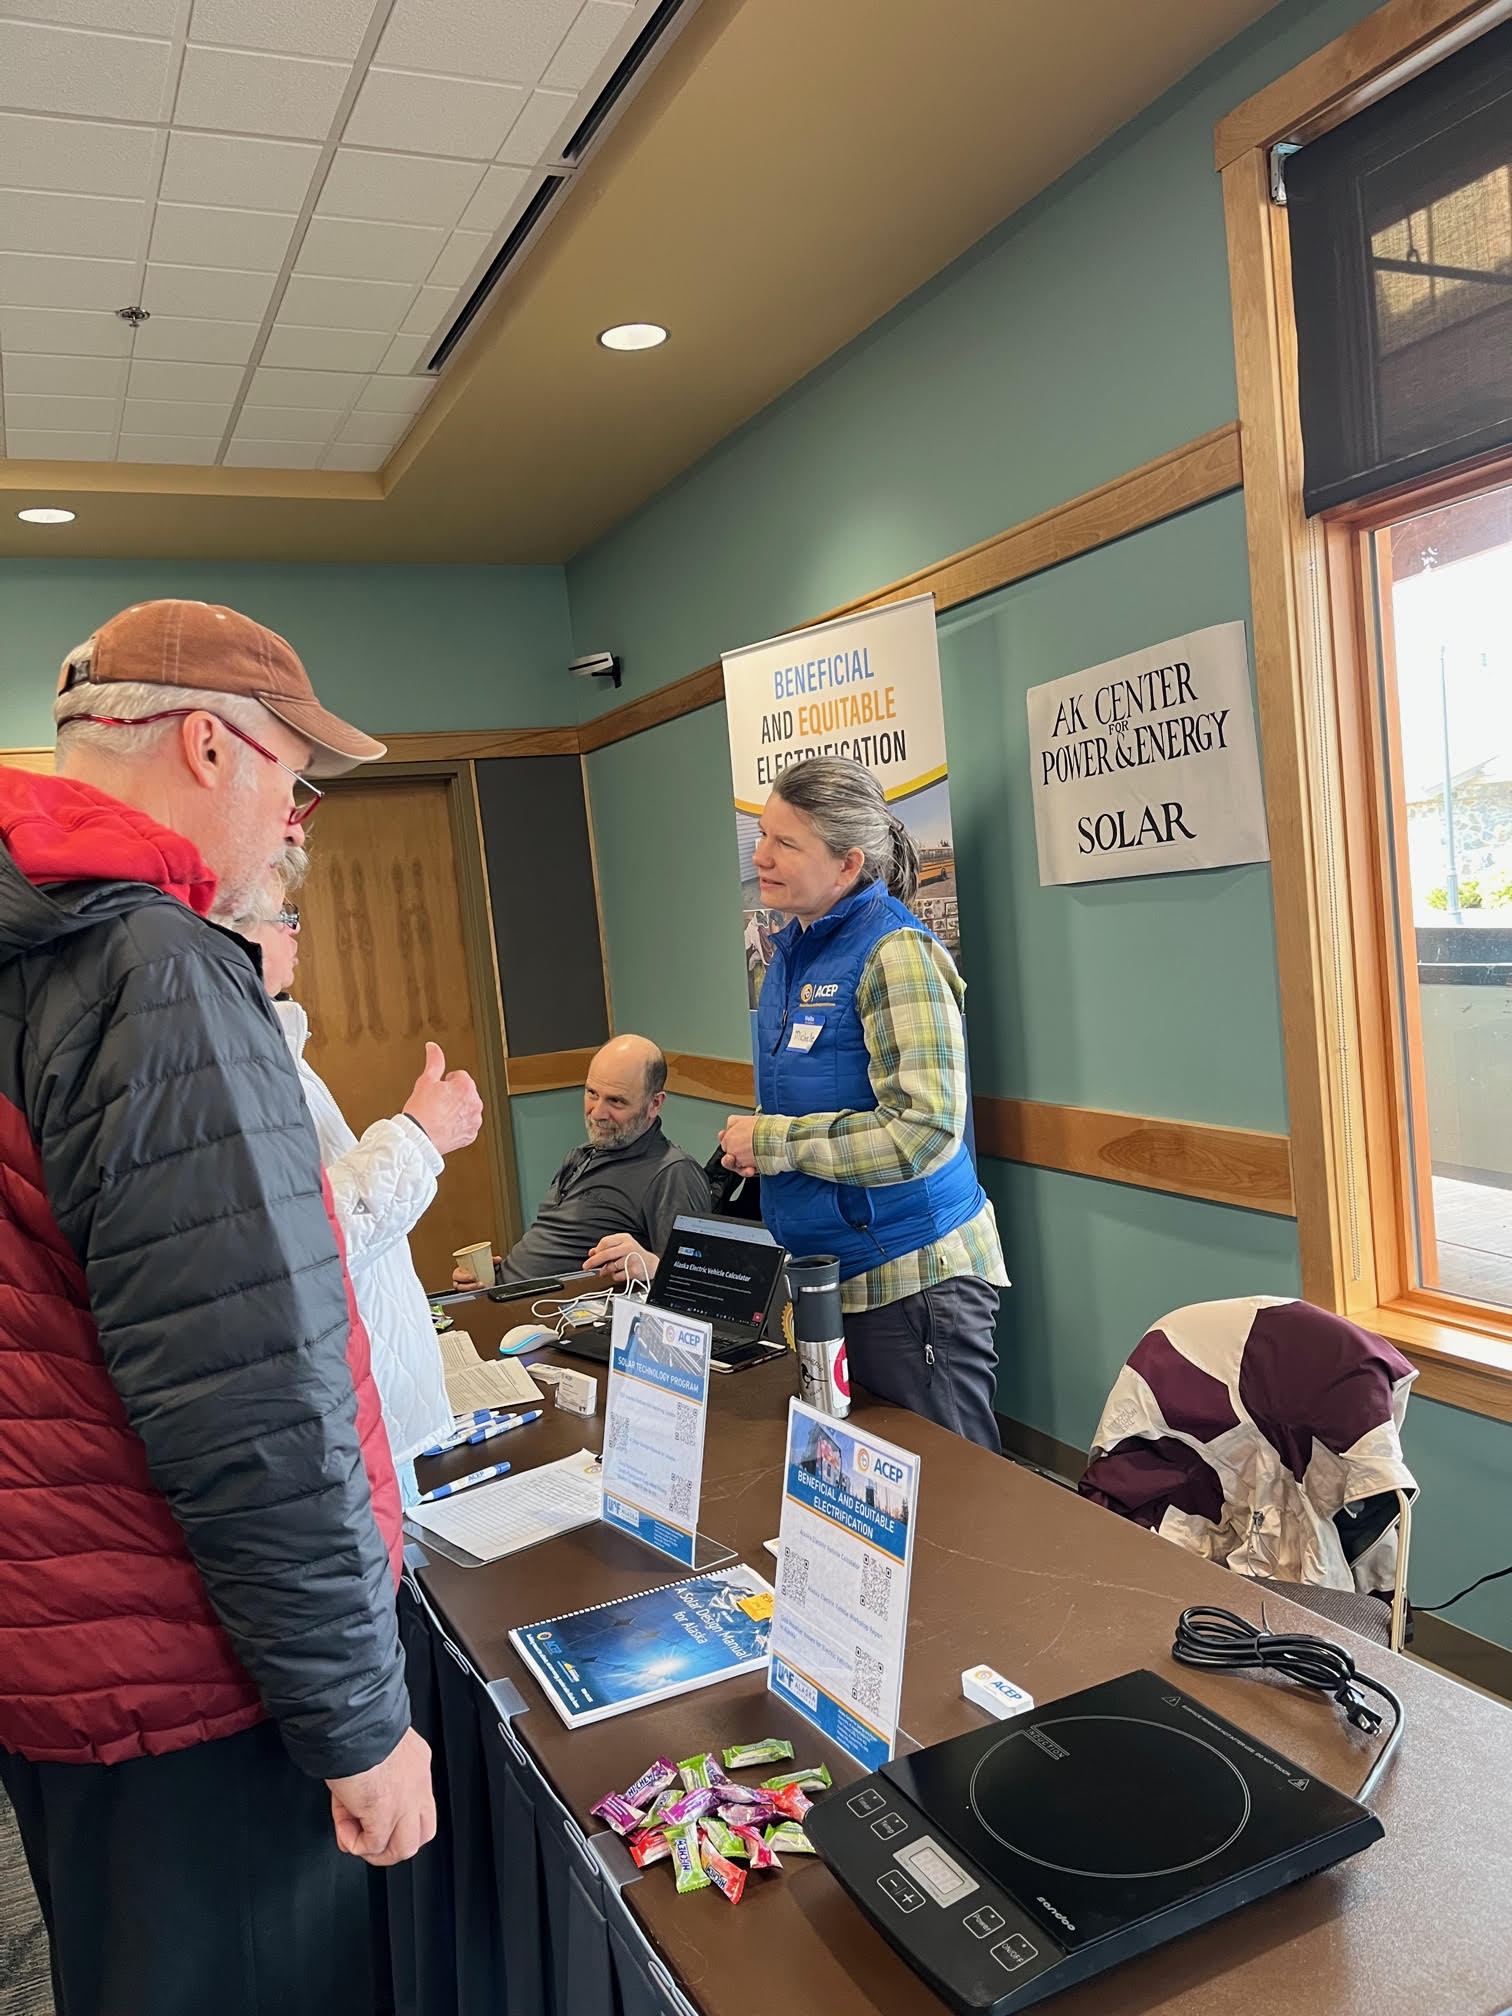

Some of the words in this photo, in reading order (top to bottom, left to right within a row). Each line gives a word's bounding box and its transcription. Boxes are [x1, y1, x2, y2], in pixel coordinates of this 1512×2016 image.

[774, 648, 874, 700] BENEFICIAL
[1051, 694, 1088, 737] AK
[1094, 662, 1199, 725] CENTER
[761, 710, 793, 744] AND
[798, 686, 897, 736] EQUITABLE
[1108, 720, 1129, 735] FOR
[1041, 737, 1115, 786] POWER
[1133, 709, 1231, 766] ENERGY
[1077, 802, 1197, 854] SOLAR
[815, 984, 839, 998] ACEP
[673, 1260, 689, 1270] Alaska
[689, 1263, 707, 1274] Electric
[707, 1266, 725, 1277] Vehicle
[725, 1271, 751, 1282] Calculator
[678, 1331, 700, 1347] ACEP
[636, 1362, 670, 1382] TECHNOLOGY
[670, 1375, 699, 1393] PROGRAM
[873, 1458, 903, 1483] ACEP
[797, 1470, 837, 1500] BENEFICIAL
[838, 1492, 853, 1509] AND
[854, 1498, 895, 1534] EQUITABLE
[813, 1496, 874, 1539] ELECTRIFICATION
[674, 1587, 688, 1595] A
[679, 1592, 702, 1610] Solar
[672, 1610, 688, 1623] for
[681, 1622, 708, 1645] Alaska
[696, 1608, 723, 1633] Design
[720, 1631, 752, 1660] Manual
[991, 1681, 1022, 1700] ACEP
[1026, 1729, 1065, 1758] INDUCTION
[973, 1913, 992, 1933] Power
[1036, 1896, 1076, 1931] sandoo
[1001, 1943, 1024, 1964] ON/OFF
